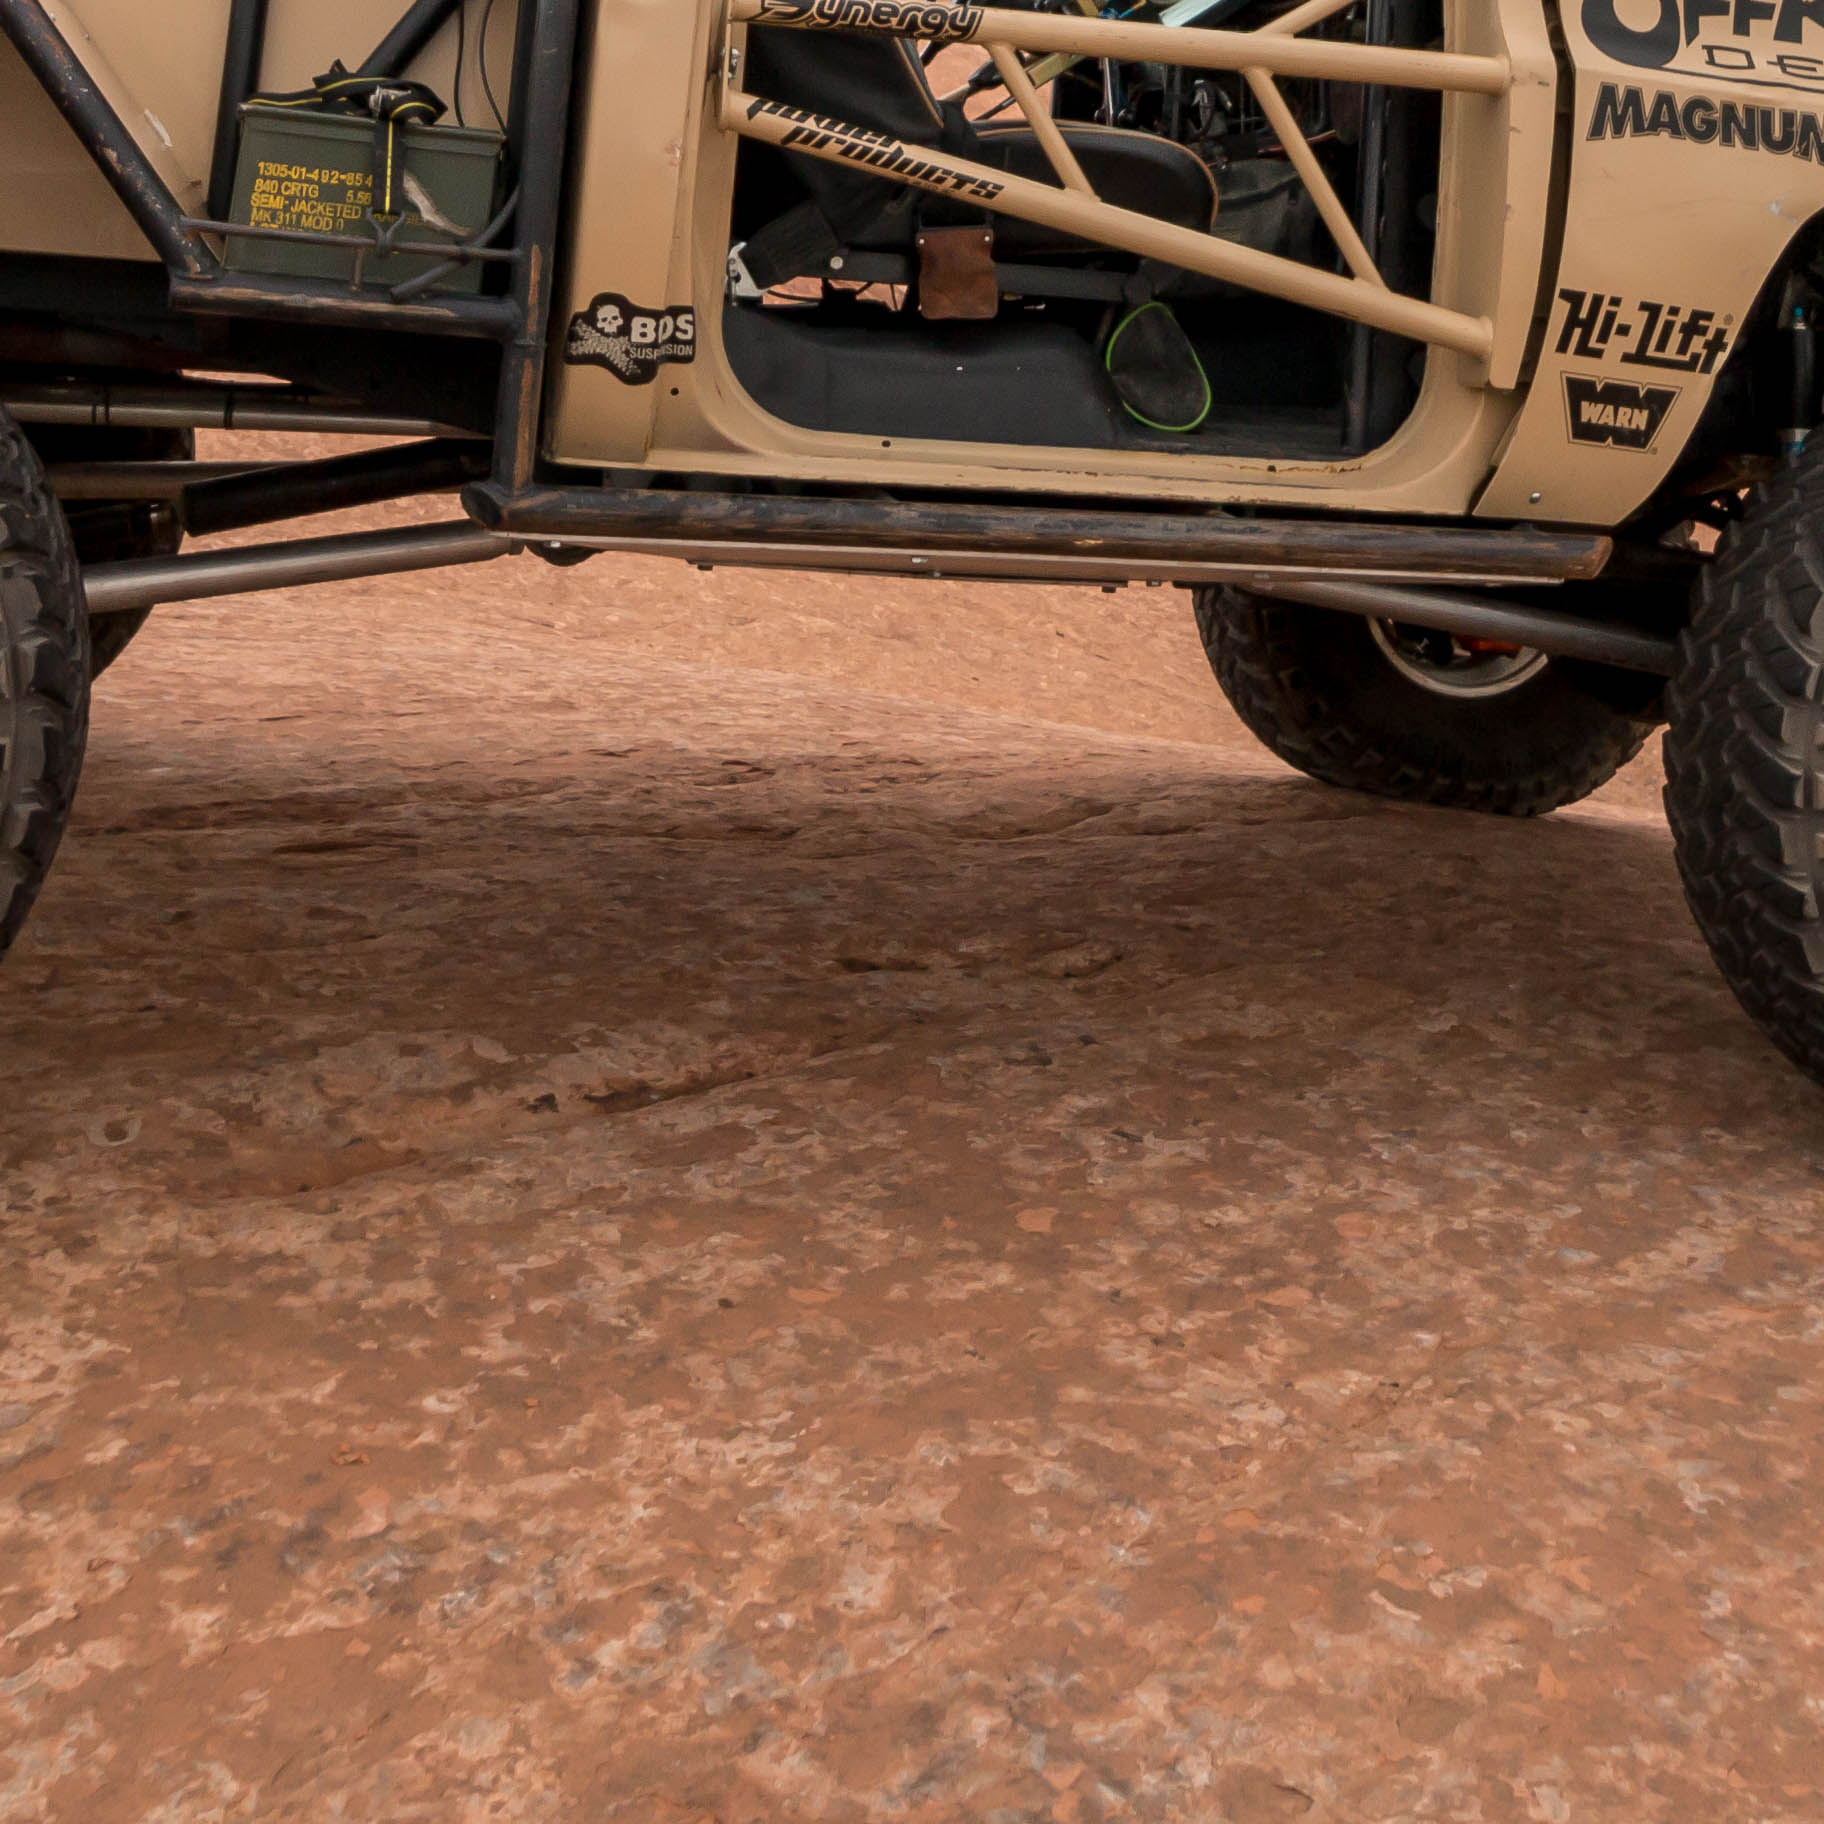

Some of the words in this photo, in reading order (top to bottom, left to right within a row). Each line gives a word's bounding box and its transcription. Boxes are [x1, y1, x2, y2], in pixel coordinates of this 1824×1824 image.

[254, 178, 279, 194] 840
[280, 182, 320, 199] CRTG
[250, 207, 272, 223] MK
[275, 210, 297, 225] 311
[300, 214, 333, 232] MOD
[290, 197, 363, 220] JACKETED
[630, 313, 694, 344] BDS
[1580, 401, 1650, 432] WARN
